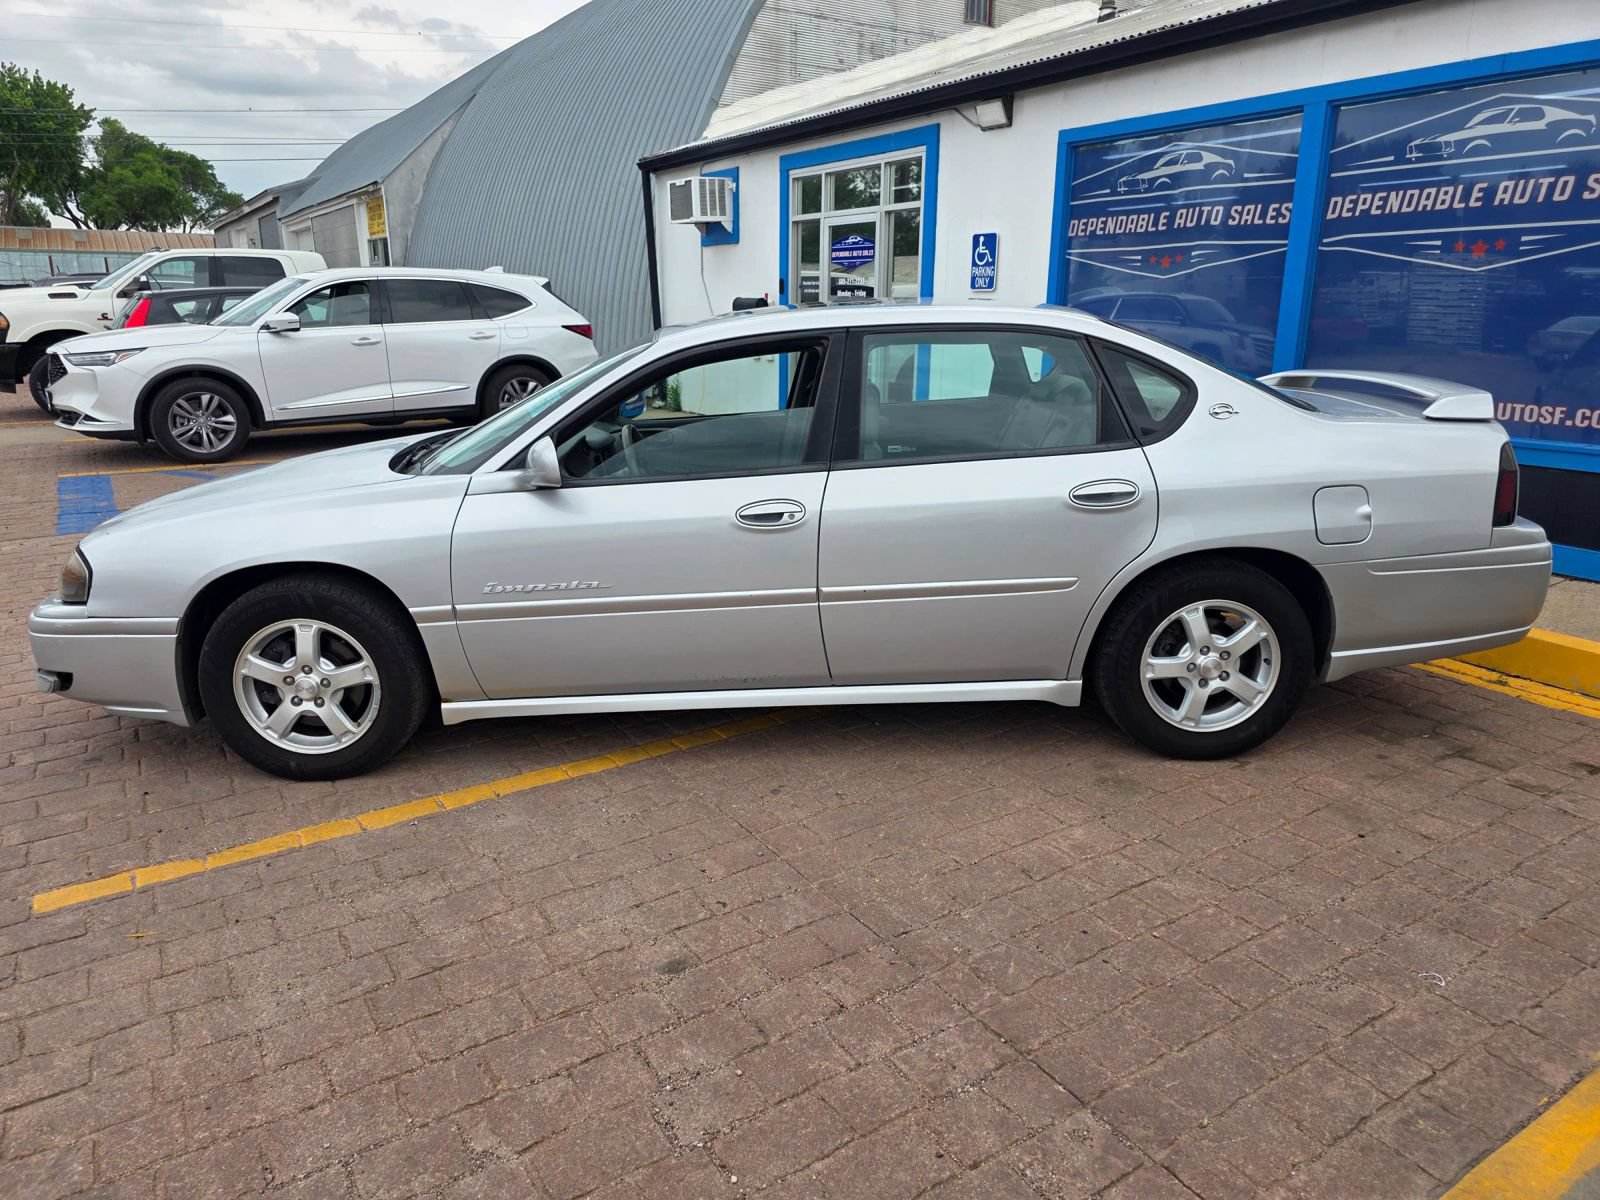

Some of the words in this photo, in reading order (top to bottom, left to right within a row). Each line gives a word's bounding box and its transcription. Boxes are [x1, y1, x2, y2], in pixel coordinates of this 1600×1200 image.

[1326, 182, 1489, 220] DEPENDABLE
[1493, 175, 1577, 206] AUTO
[1067, 211, 1170, 237] DEPENDABLE
[1173, 205, 1224, 229] AUTO
[1228, 202, 1293, 226] SALES
[971, 265, 995, 277] PARKING
[975, 276, 990, 288] ONLY
[837, 289, 852, 298] Monday
[855, 289, 867, 298] Friday
[1493, 402, 1600, 429] UTOSF.CO
